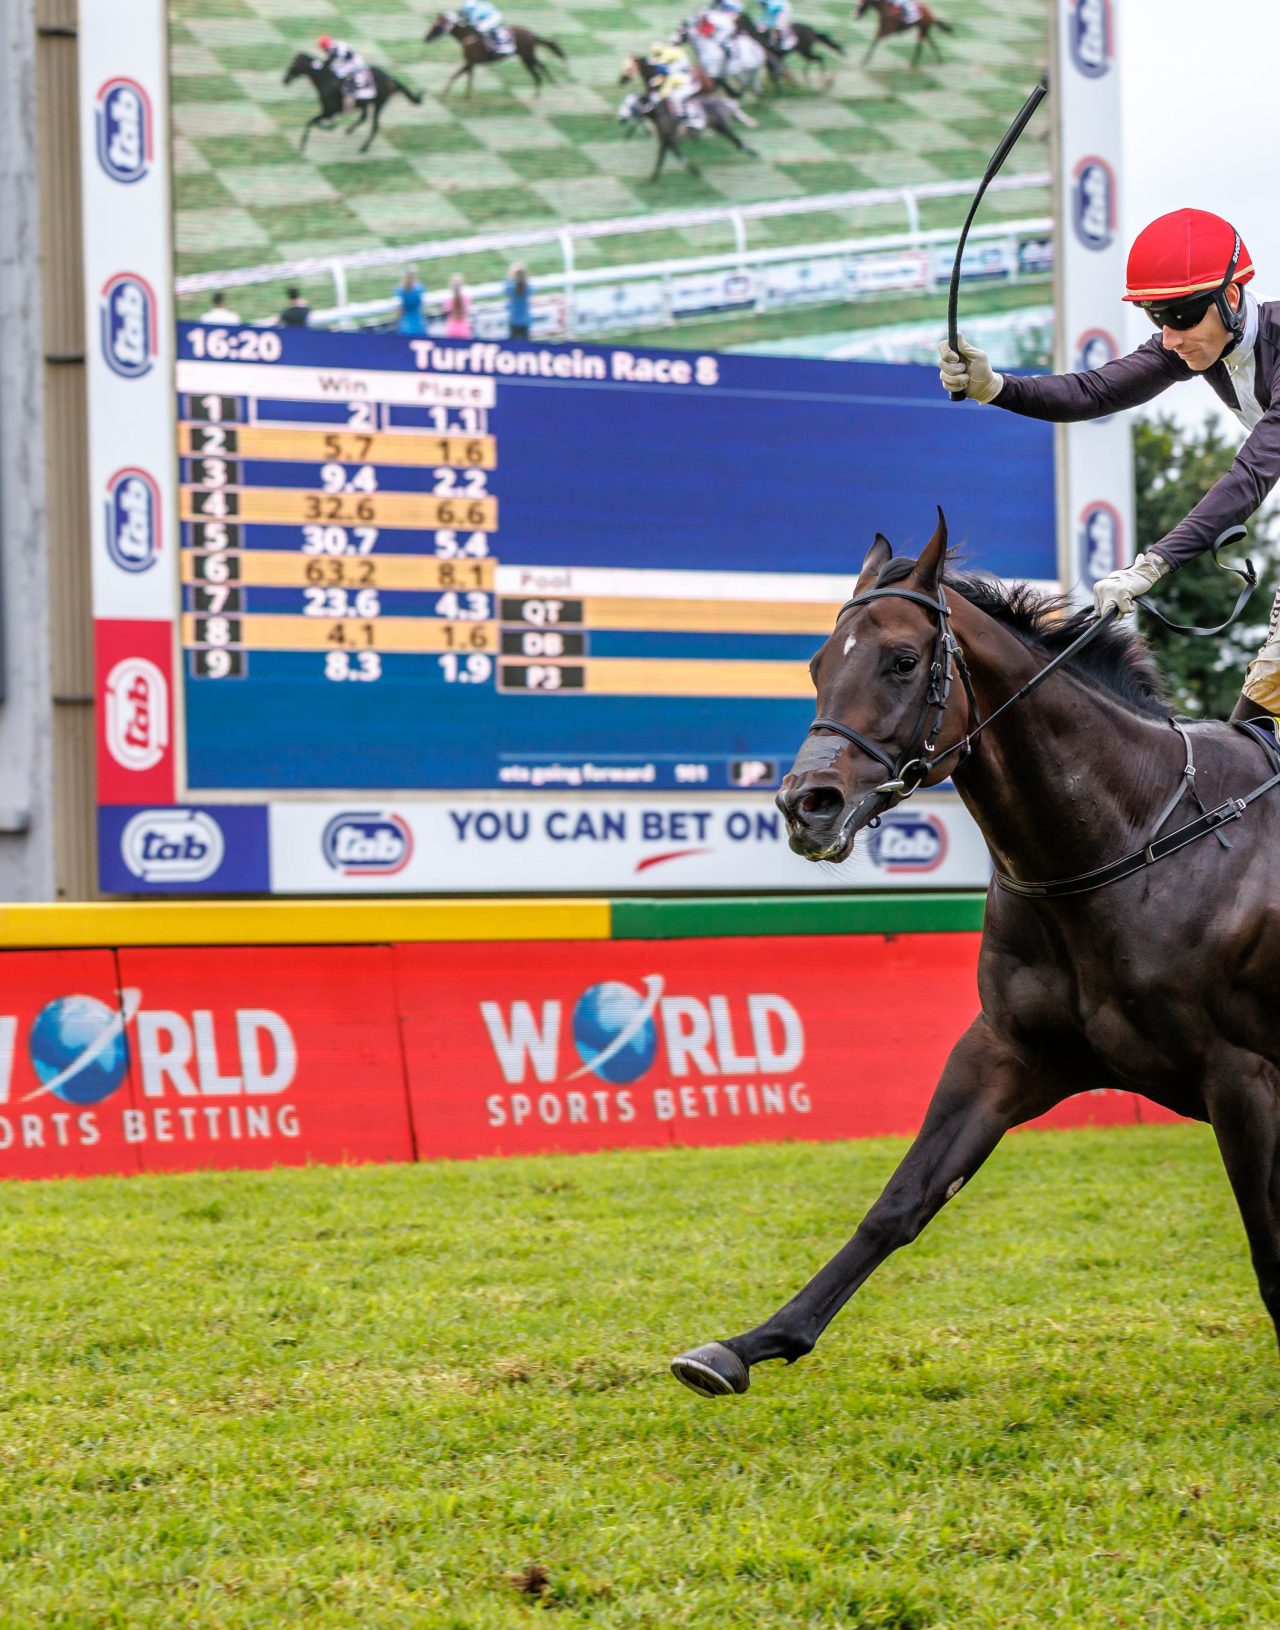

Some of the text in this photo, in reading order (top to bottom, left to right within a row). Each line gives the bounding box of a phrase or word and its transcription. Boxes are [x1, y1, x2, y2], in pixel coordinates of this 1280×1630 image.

[187, 328, 281, 361] 16:20
[410, 341, 719, 385] Turffontein Race 8
[318, 376, 482, 399] Win Place
[202, 396, 478, 433] 1 2 1.1
[202, 428, 484, 465] 2 5.7 1.6
[202, 459, 488, 497] 3 9.4 2.2
[202, 489, 485, 525] 4 32.6 6.6
[204, 523, 488, 558] 5 30.7 5.4
[204, 555, 483, 587] 6 63.2 8.1
[520, 571, 572, 588] Pool
[204, 586, 490, 620] 7 23.6 4.3
[522, 599, 563, 626] QT
[205, 617, 488, 648] 8 4.1 1.6
[205, 649, 491, 683] 9 8.3 1.9
[526, 665, 562, 690] P3
[449, 810, 780, 841] YOU CAN BET ON
[141, 831, 208, 861] tab
[0, 988, 298, 1105] ORLD
[486, 1082, 812, 1127] SPORTS BETTING
[122, 1105, 302, 1143] BETTING
